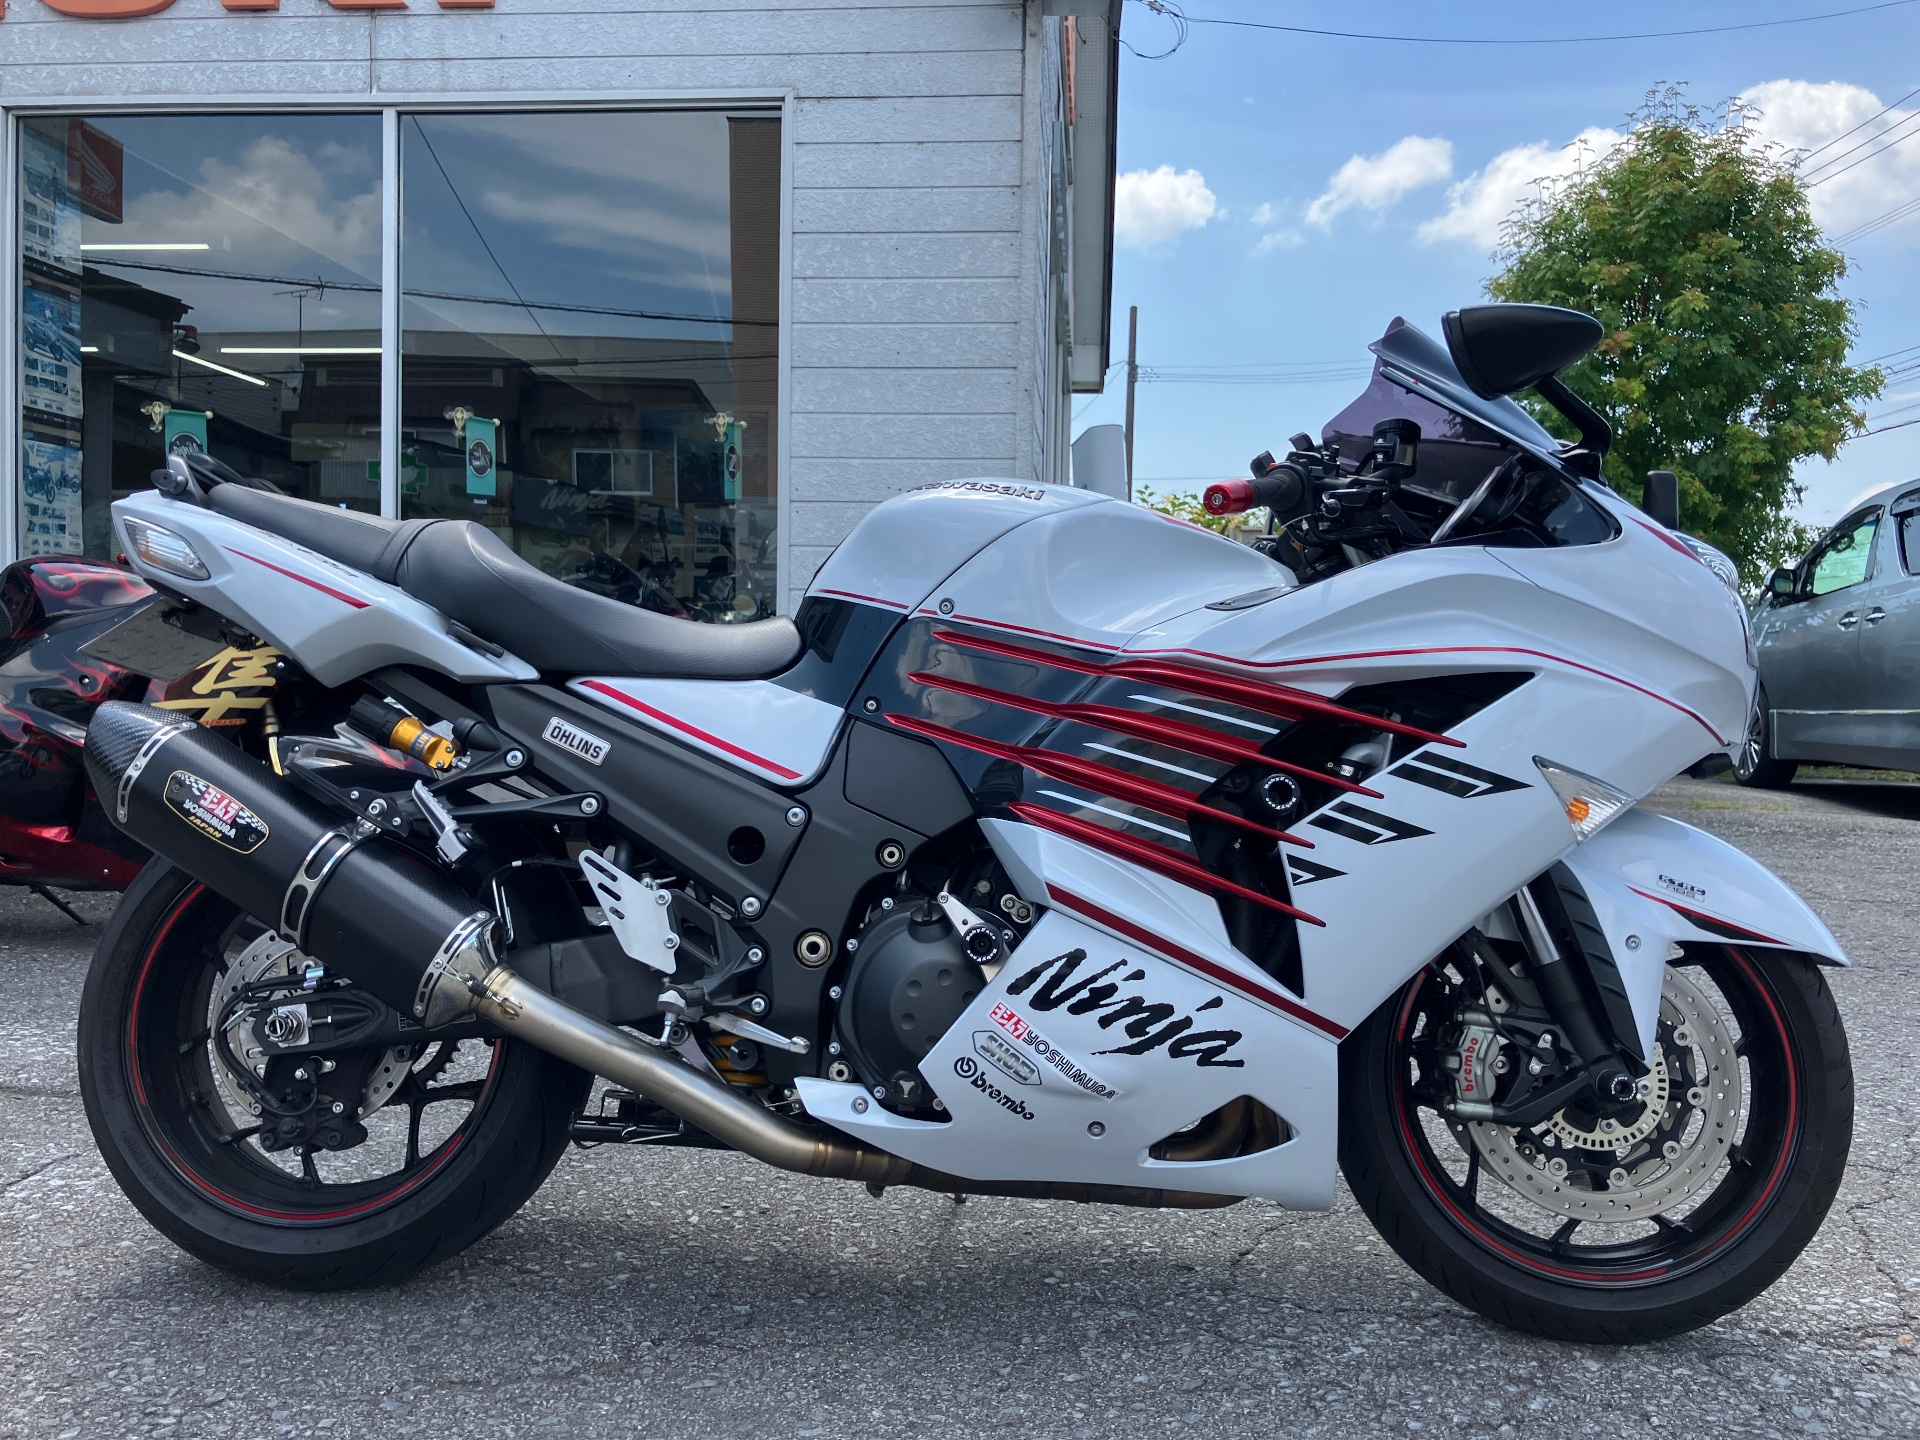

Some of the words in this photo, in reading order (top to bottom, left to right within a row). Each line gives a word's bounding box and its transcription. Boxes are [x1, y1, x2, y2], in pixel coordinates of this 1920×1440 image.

[550, 721, 602, 759] ÖHLINS
[183, 799, 236, 838] YOSHIMURA
[188, 816, 222, 838] JAPAN
[990, 1003, 1029, 1039] ヨシムラ
[1006, 948, 1245, 1067] Ninja
[980, 1035, 1036, 1081] SHOEI
[1022, 1030, 1116, 1099] YOSHIMURA
[1462, 1037, 1479, 1093] brembo
[970, 1071, 1035, 1121] brembo
